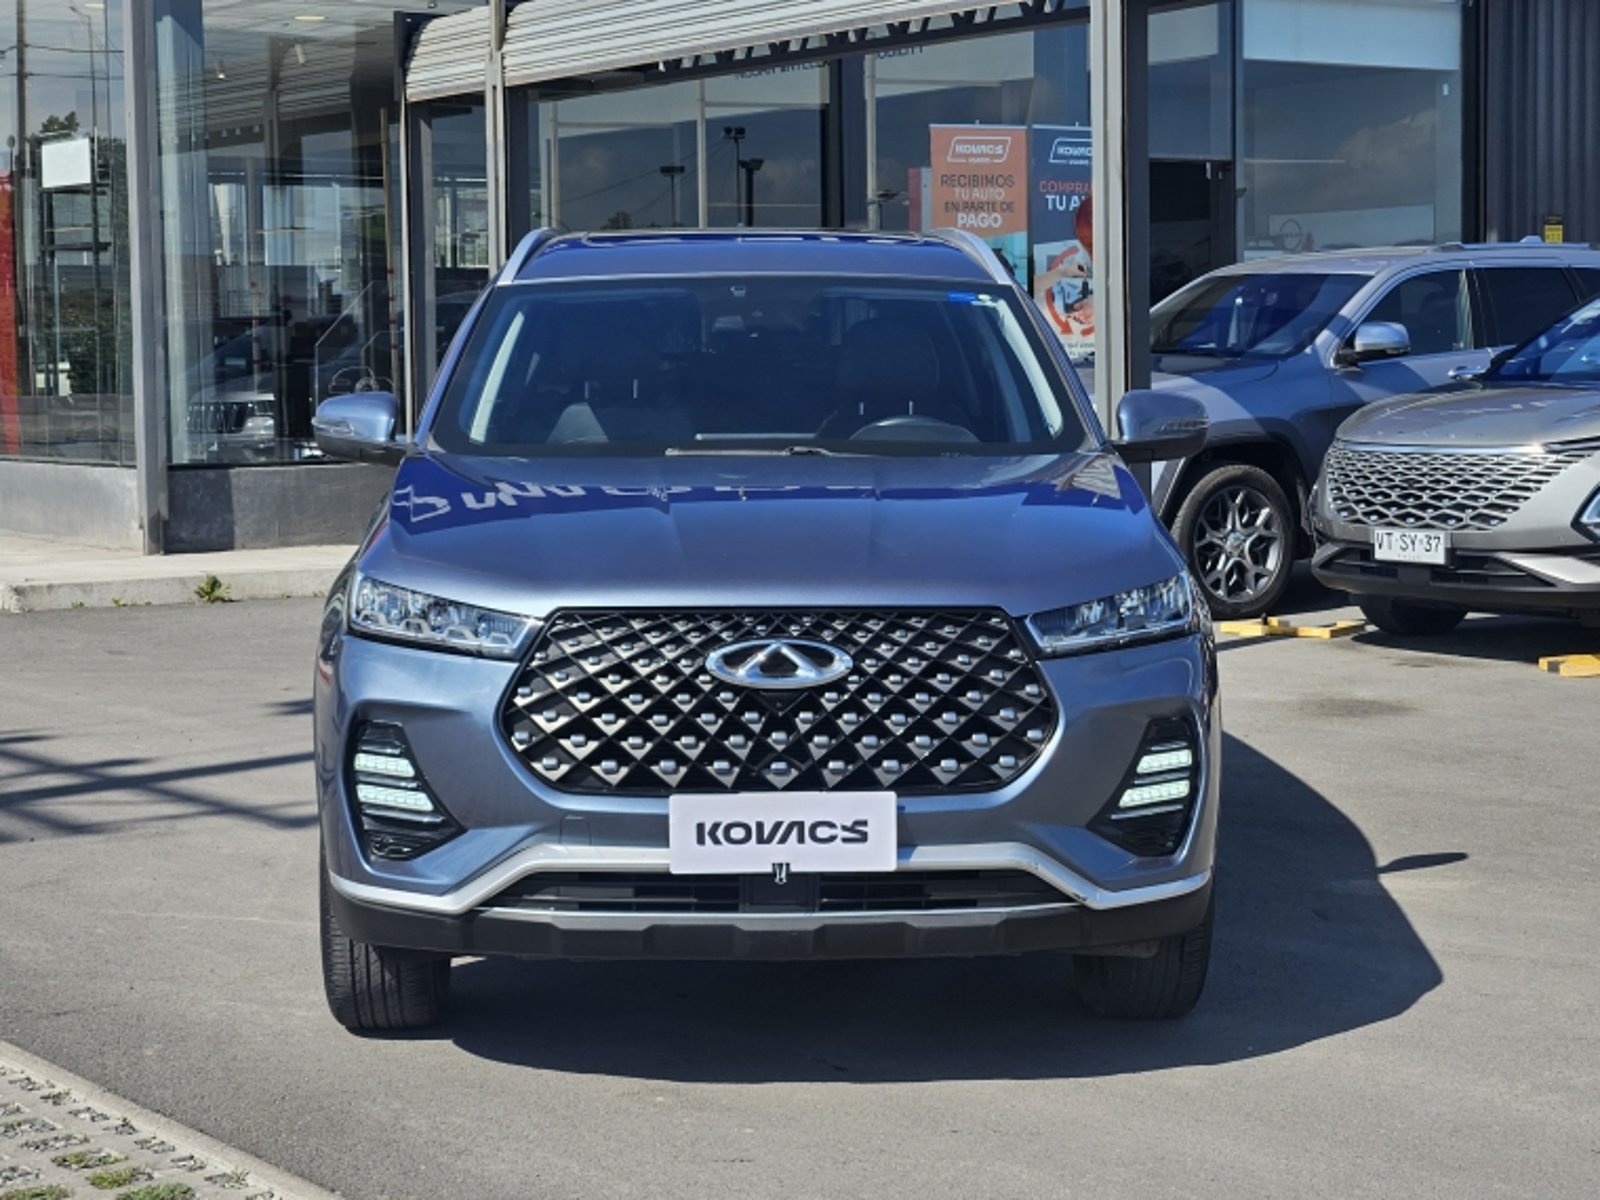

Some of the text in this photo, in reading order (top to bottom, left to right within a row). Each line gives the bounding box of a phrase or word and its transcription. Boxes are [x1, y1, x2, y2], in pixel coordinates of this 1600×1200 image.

[955, 144, 1003, 154] KOVACS
[941, 174, 1015, 188] RECIBIMOS
[953, 188, 1005, 200] TU AUTO
[944, 201, 1015, 213] EN PARTE DE
[1045, 195, 1086, 211] TU A
[957, 213, 1002, 228] PAGO
[696, 819, 868, 847] KOVACS
